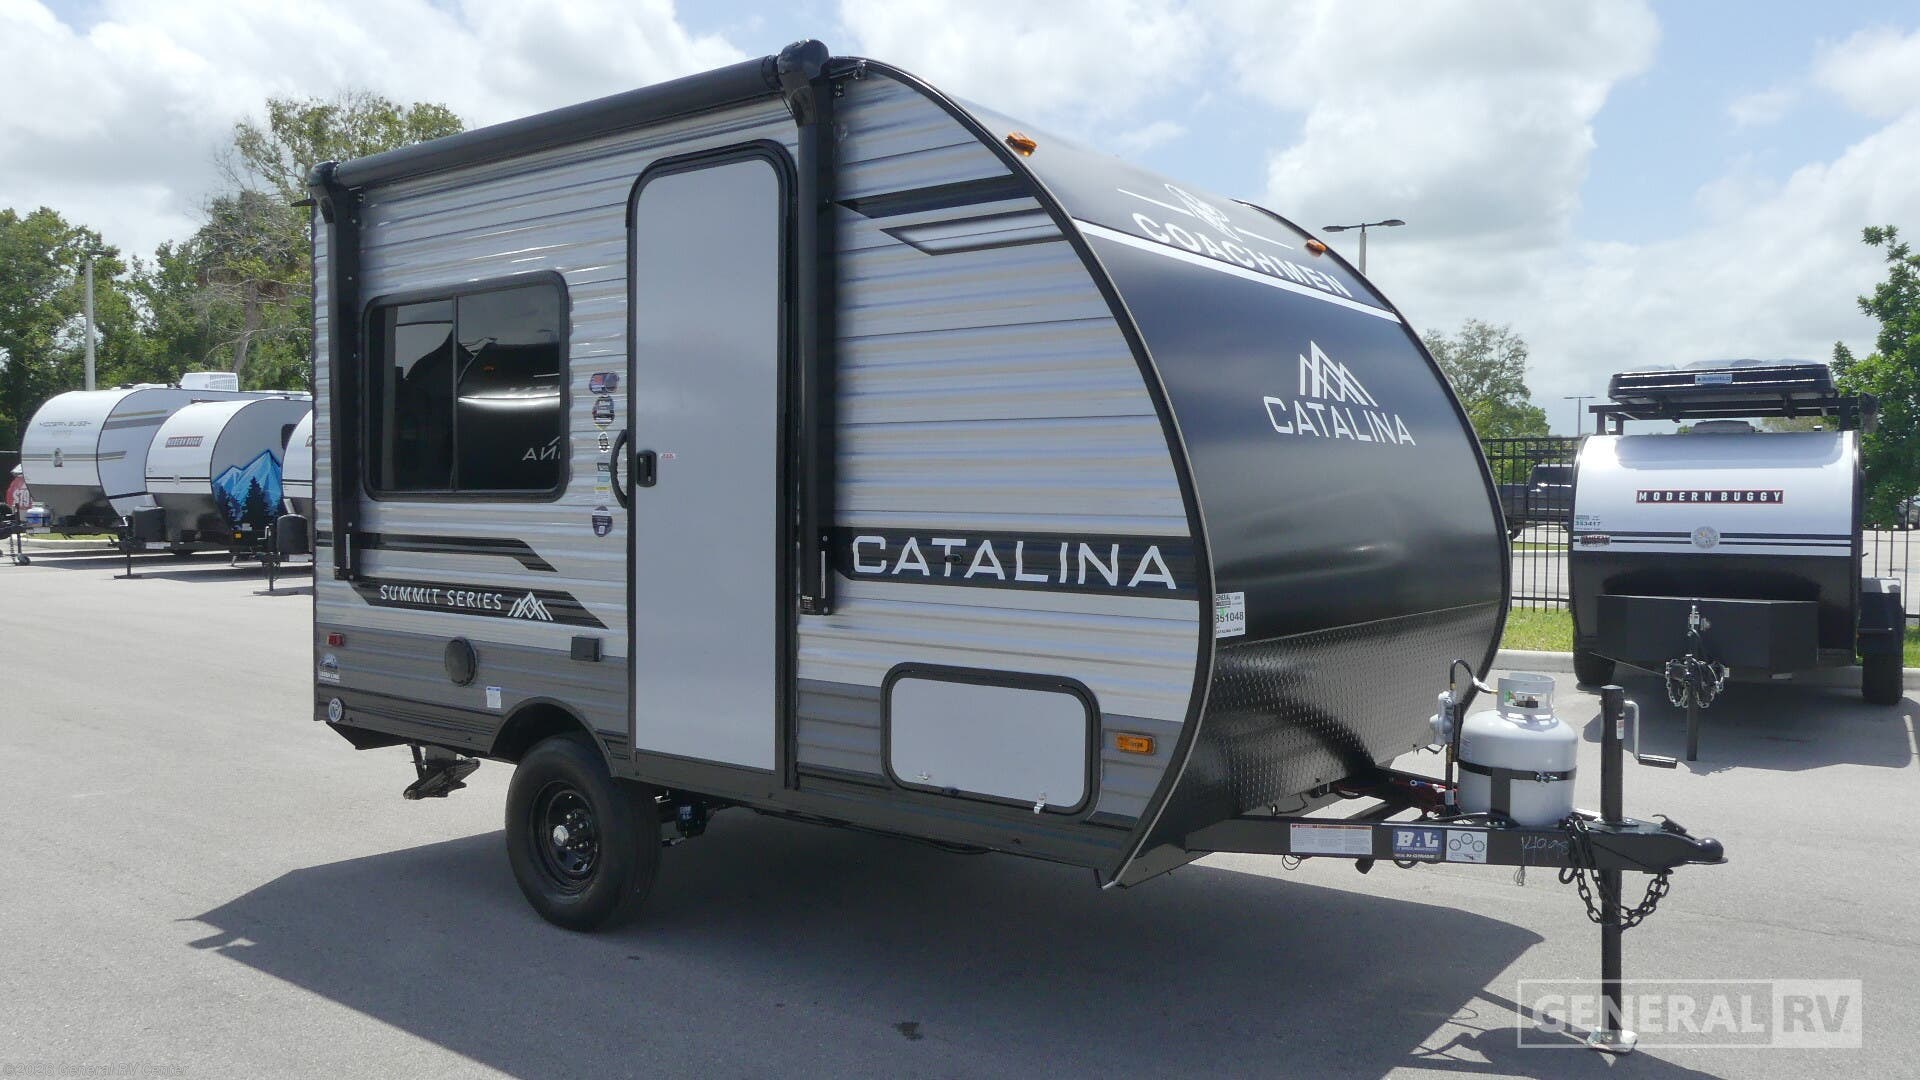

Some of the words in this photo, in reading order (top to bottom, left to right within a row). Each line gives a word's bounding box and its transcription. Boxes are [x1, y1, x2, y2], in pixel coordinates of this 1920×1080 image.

[1131, 213, 1353, 298] COACHMEN
[1263, 396, 1416, 446] CATALINA
[1638, 491, 1712, 502] MODERN
[1720, 491, 1781, 502] BUGGY
[852, 535, 1177, 590] CATALINA
[380, 584, 441, 605] SUMMIT
[447, 590, 503, 610] SERIES
[1396, 831, 1440, 848] BAL
